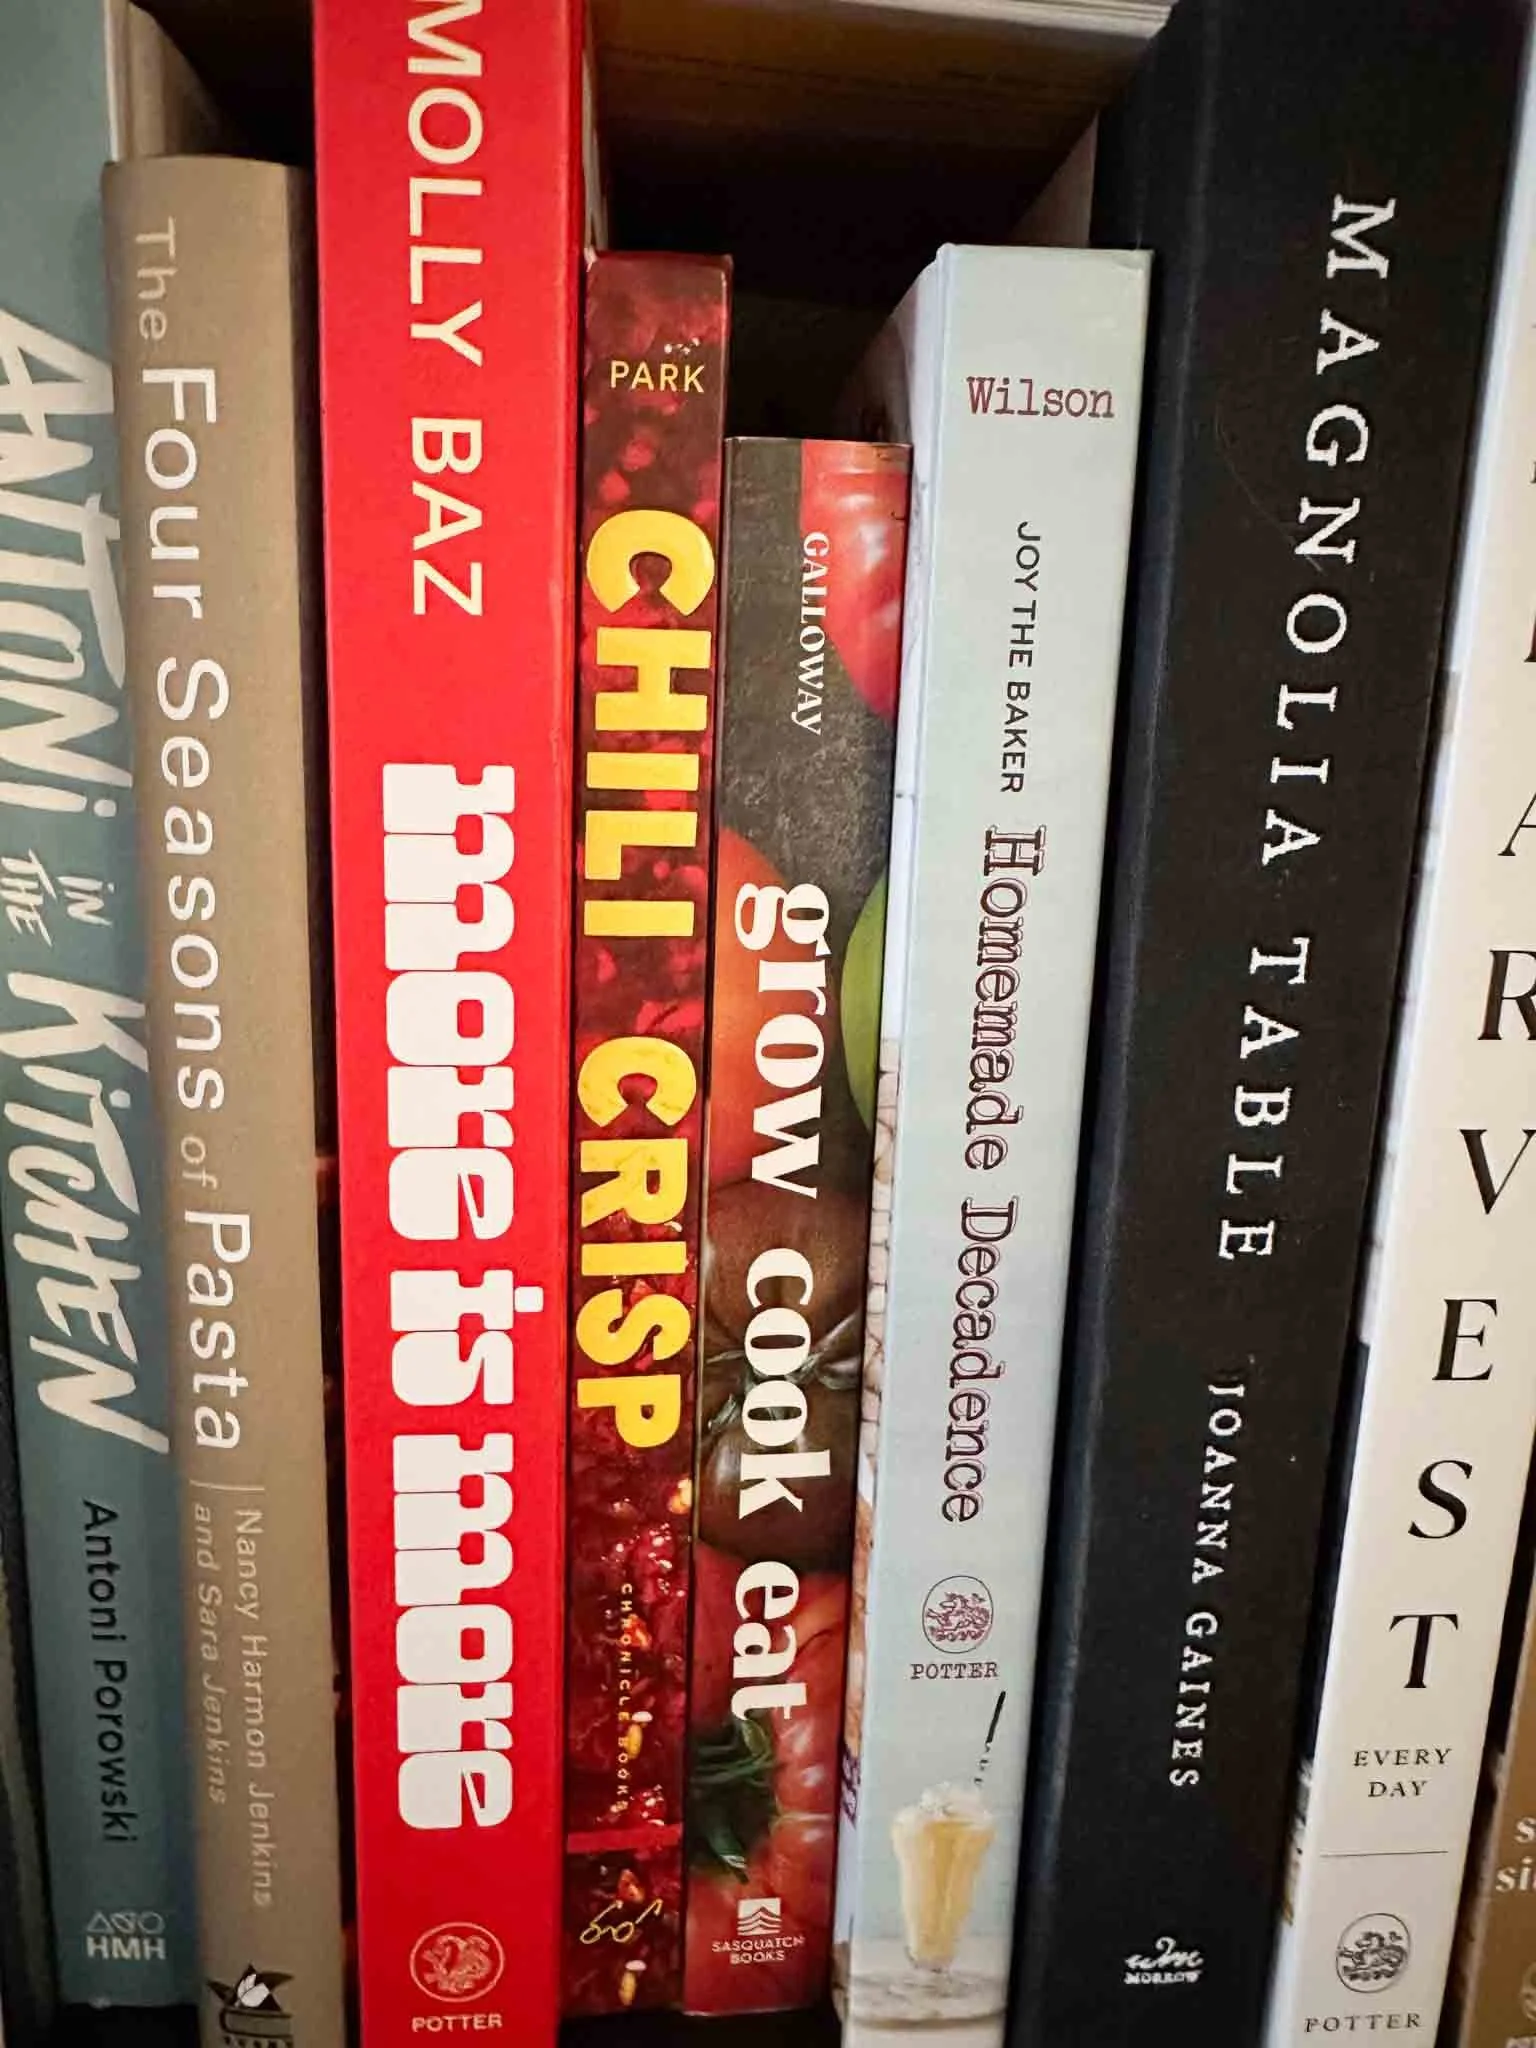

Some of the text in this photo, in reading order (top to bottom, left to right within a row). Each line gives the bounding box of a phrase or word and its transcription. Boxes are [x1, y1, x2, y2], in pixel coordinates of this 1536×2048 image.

[407, 0, 483, 616] MOLLY BAZ
[609, 359, 705, 394] PARK
[966, 376, 1115, 418] Wilson
[790, 530, 831, 736] GALLOWAY
[0, 848, 58, 948] THE
[135, 216, 251, 1449] The Four Seasons of Pasta
[576, 509, 716, 1448] CHILI CRISP
[941, 521, 1049, 1524] JOY THE BAKER Homemade Decadence
[1170, 194, 1396, 1788] MAGNOLIA TABLE JOANNA GAINES
[1389, 602, 1536, 1690] RVEST
[382, 762, 544, 1830] more is more
[731, 882, 832, 1721] grow cook eat
[82, 1499, 138, 1844] Antoni Porowski
[194, 1503, 231, 1805] and Sara Jenkins
[235, 1508, 278, 1907] Nancy Harmon Jenkins
[617, 1582, 633, 1722] CHRONICLE
[911, 1661, 999, 1680] POTTER
[1353, 1747, 1453, 1767] EVERY
[1367, 1780, 1428, 1798] DAY
[86, 1935, 166, 1961] HMH
[411, 2013, 503, 2034] POTTER
[711, 1935, 806, 1953] SASQUATCH
[730, 1949, 786, 1965] BOOKS
[1304, 2012, 1424, 2034] POTTER
